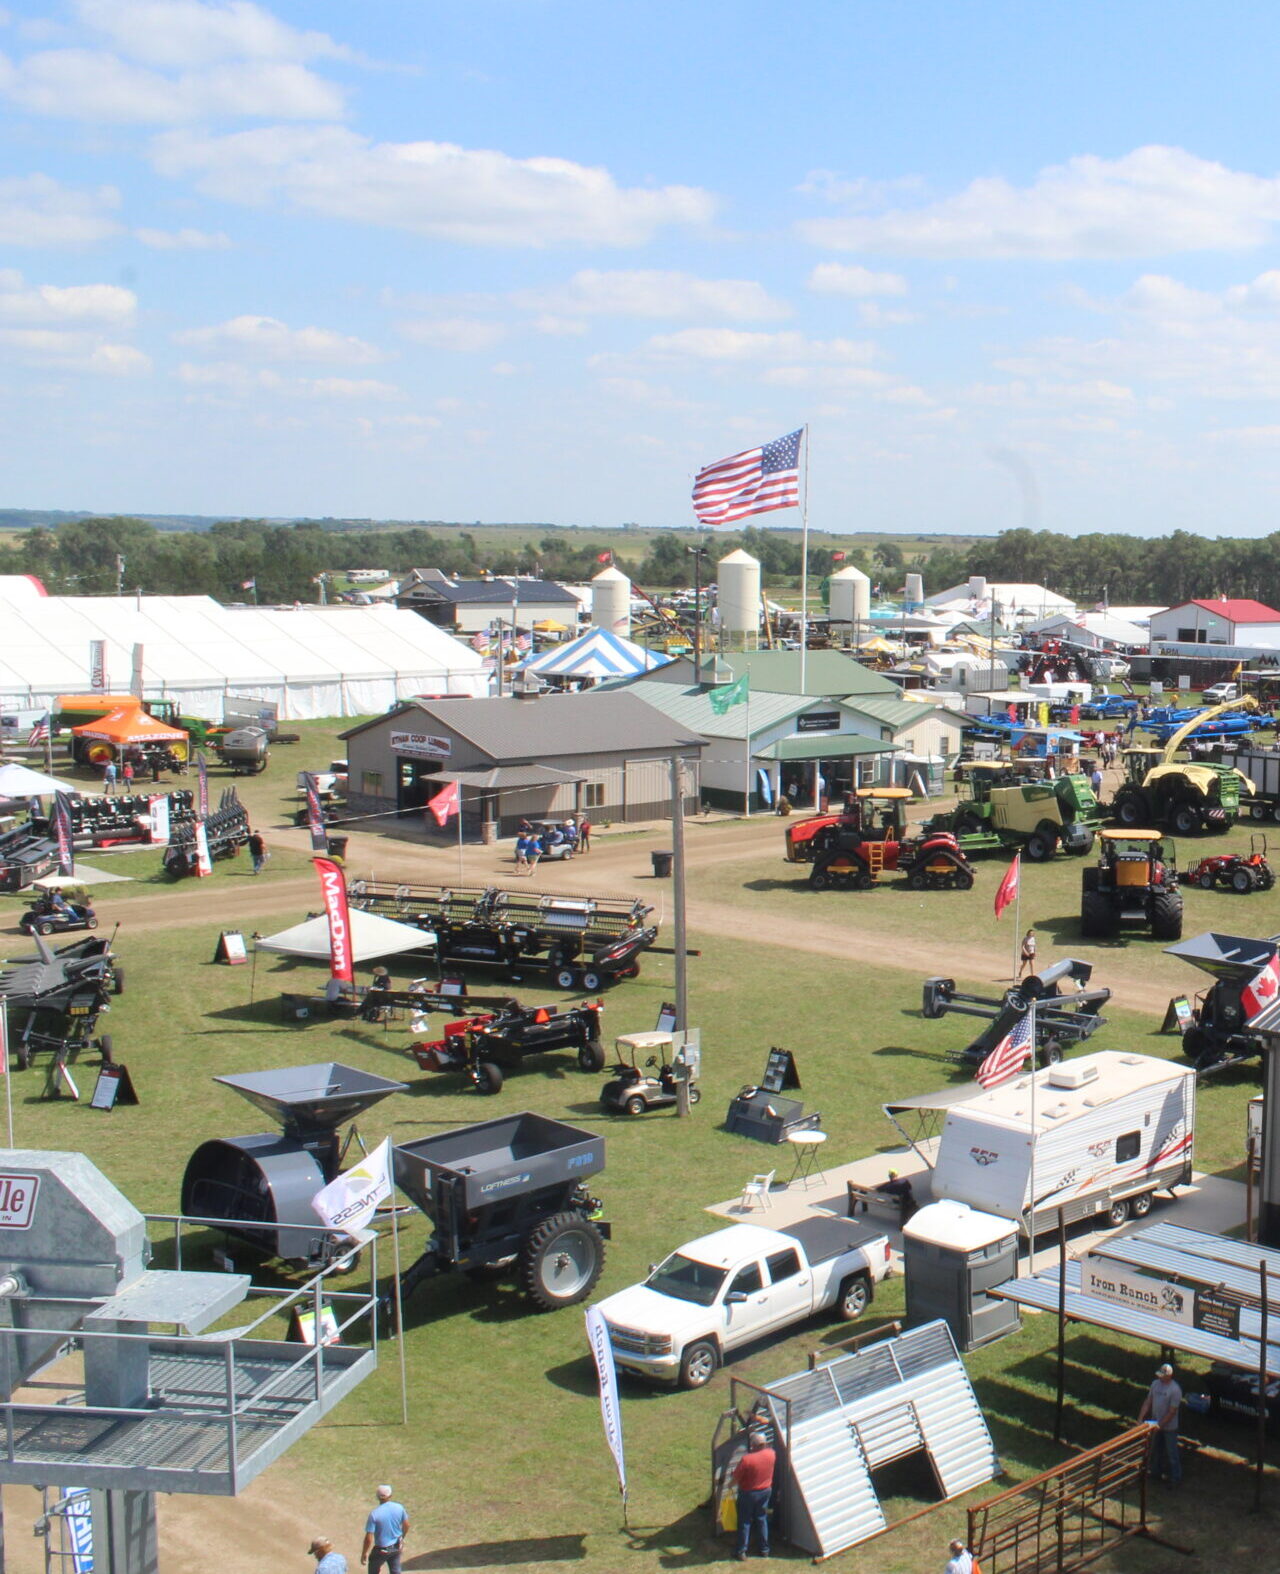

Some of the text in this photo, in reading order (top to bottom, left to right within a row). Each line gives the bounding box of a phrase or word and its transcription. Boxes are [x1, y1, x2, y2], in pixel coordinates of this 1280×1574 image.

[322, 871, 346, 971] MacDon
[480, 1174, 522, 1193] LOFTNESS
[1090, 1274, 1159, 1306] Iron Ranch
